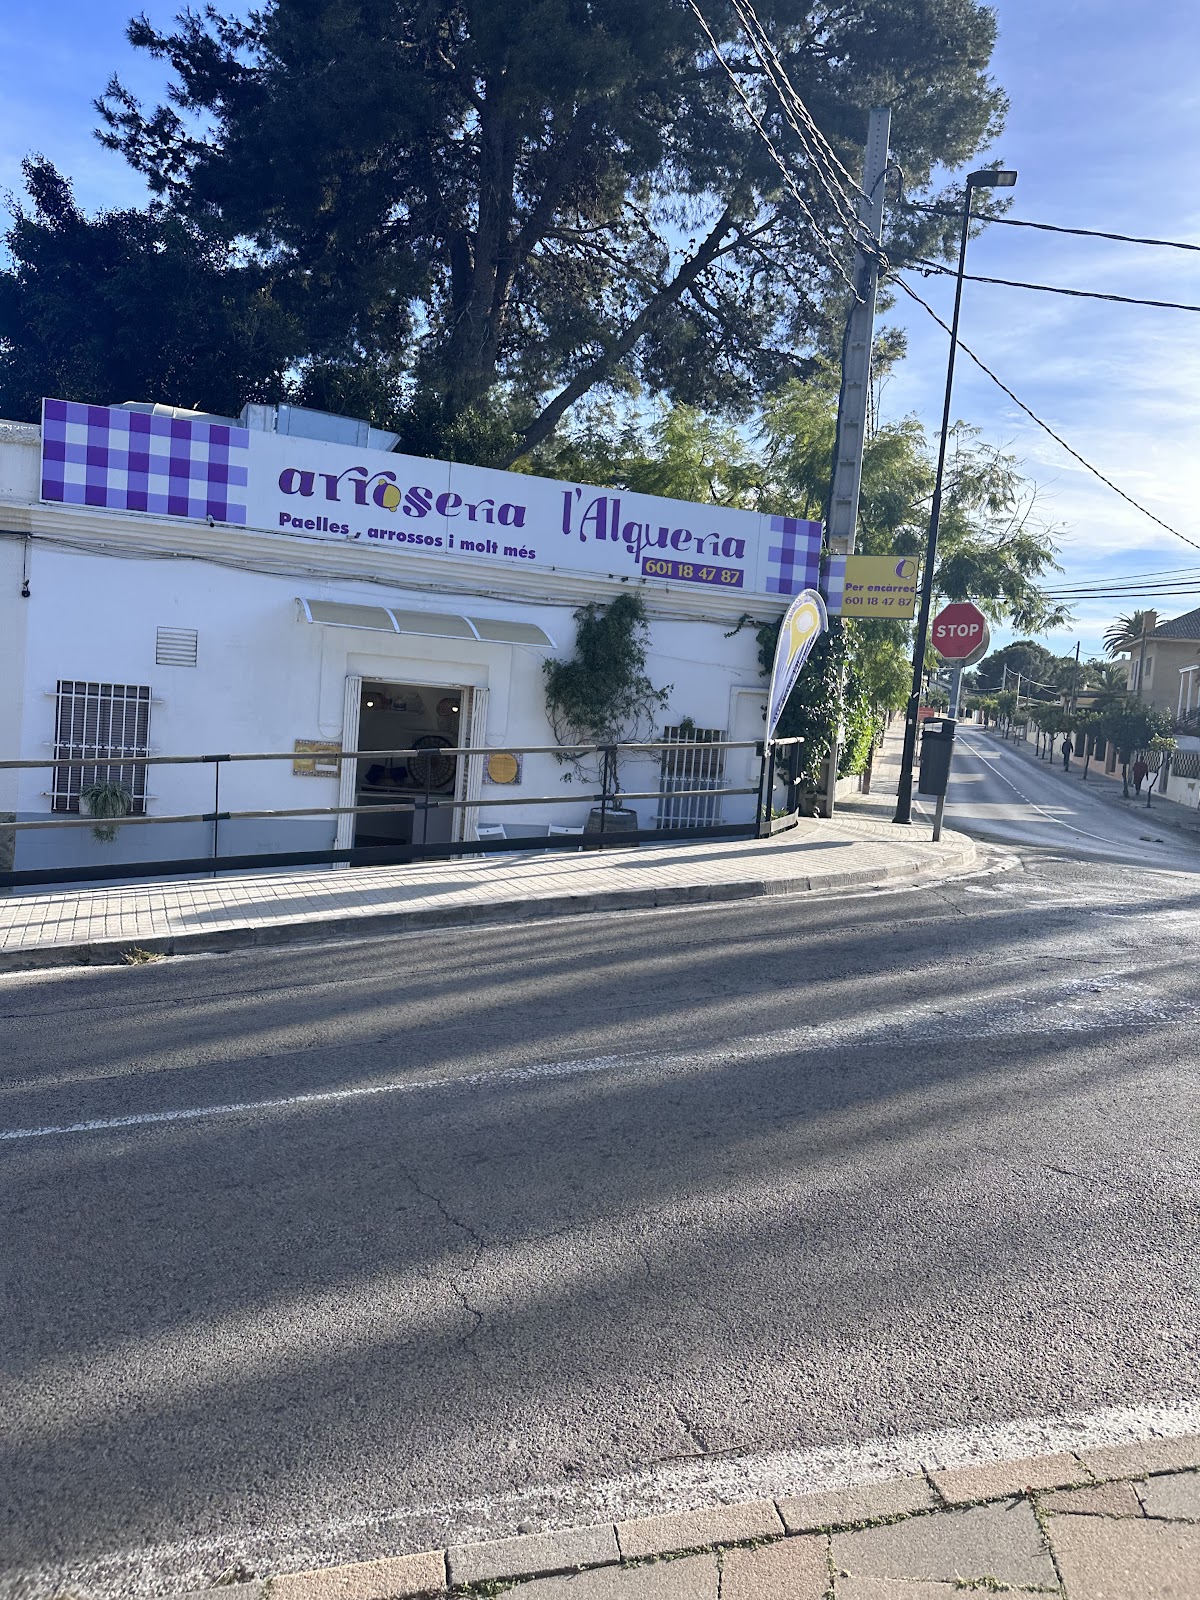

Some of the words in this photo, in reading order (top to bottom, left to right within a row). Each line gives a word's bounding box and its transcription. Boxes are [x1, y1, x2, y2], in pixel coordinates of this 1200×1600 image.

[367, 527, 443, 547] arrossos
[448, 534, 454, 548] i
[460, 539, 498, 554] molt
[503, 545, 536, 559] més
[645, 559, 672, 576] 601
[677, 564, 694, 578] 18
[698, 567, 717, 581] 47
[720, 570, 740, 584] 87
[845, 582, 864, 592] Per
[845, 596, 863, 605] 601
[867, 597, 878, 605] 18
[881, 597, 895, 606] 47
[898, 598, 912, 606] 87
[936, 623, 980, 638] STOP
